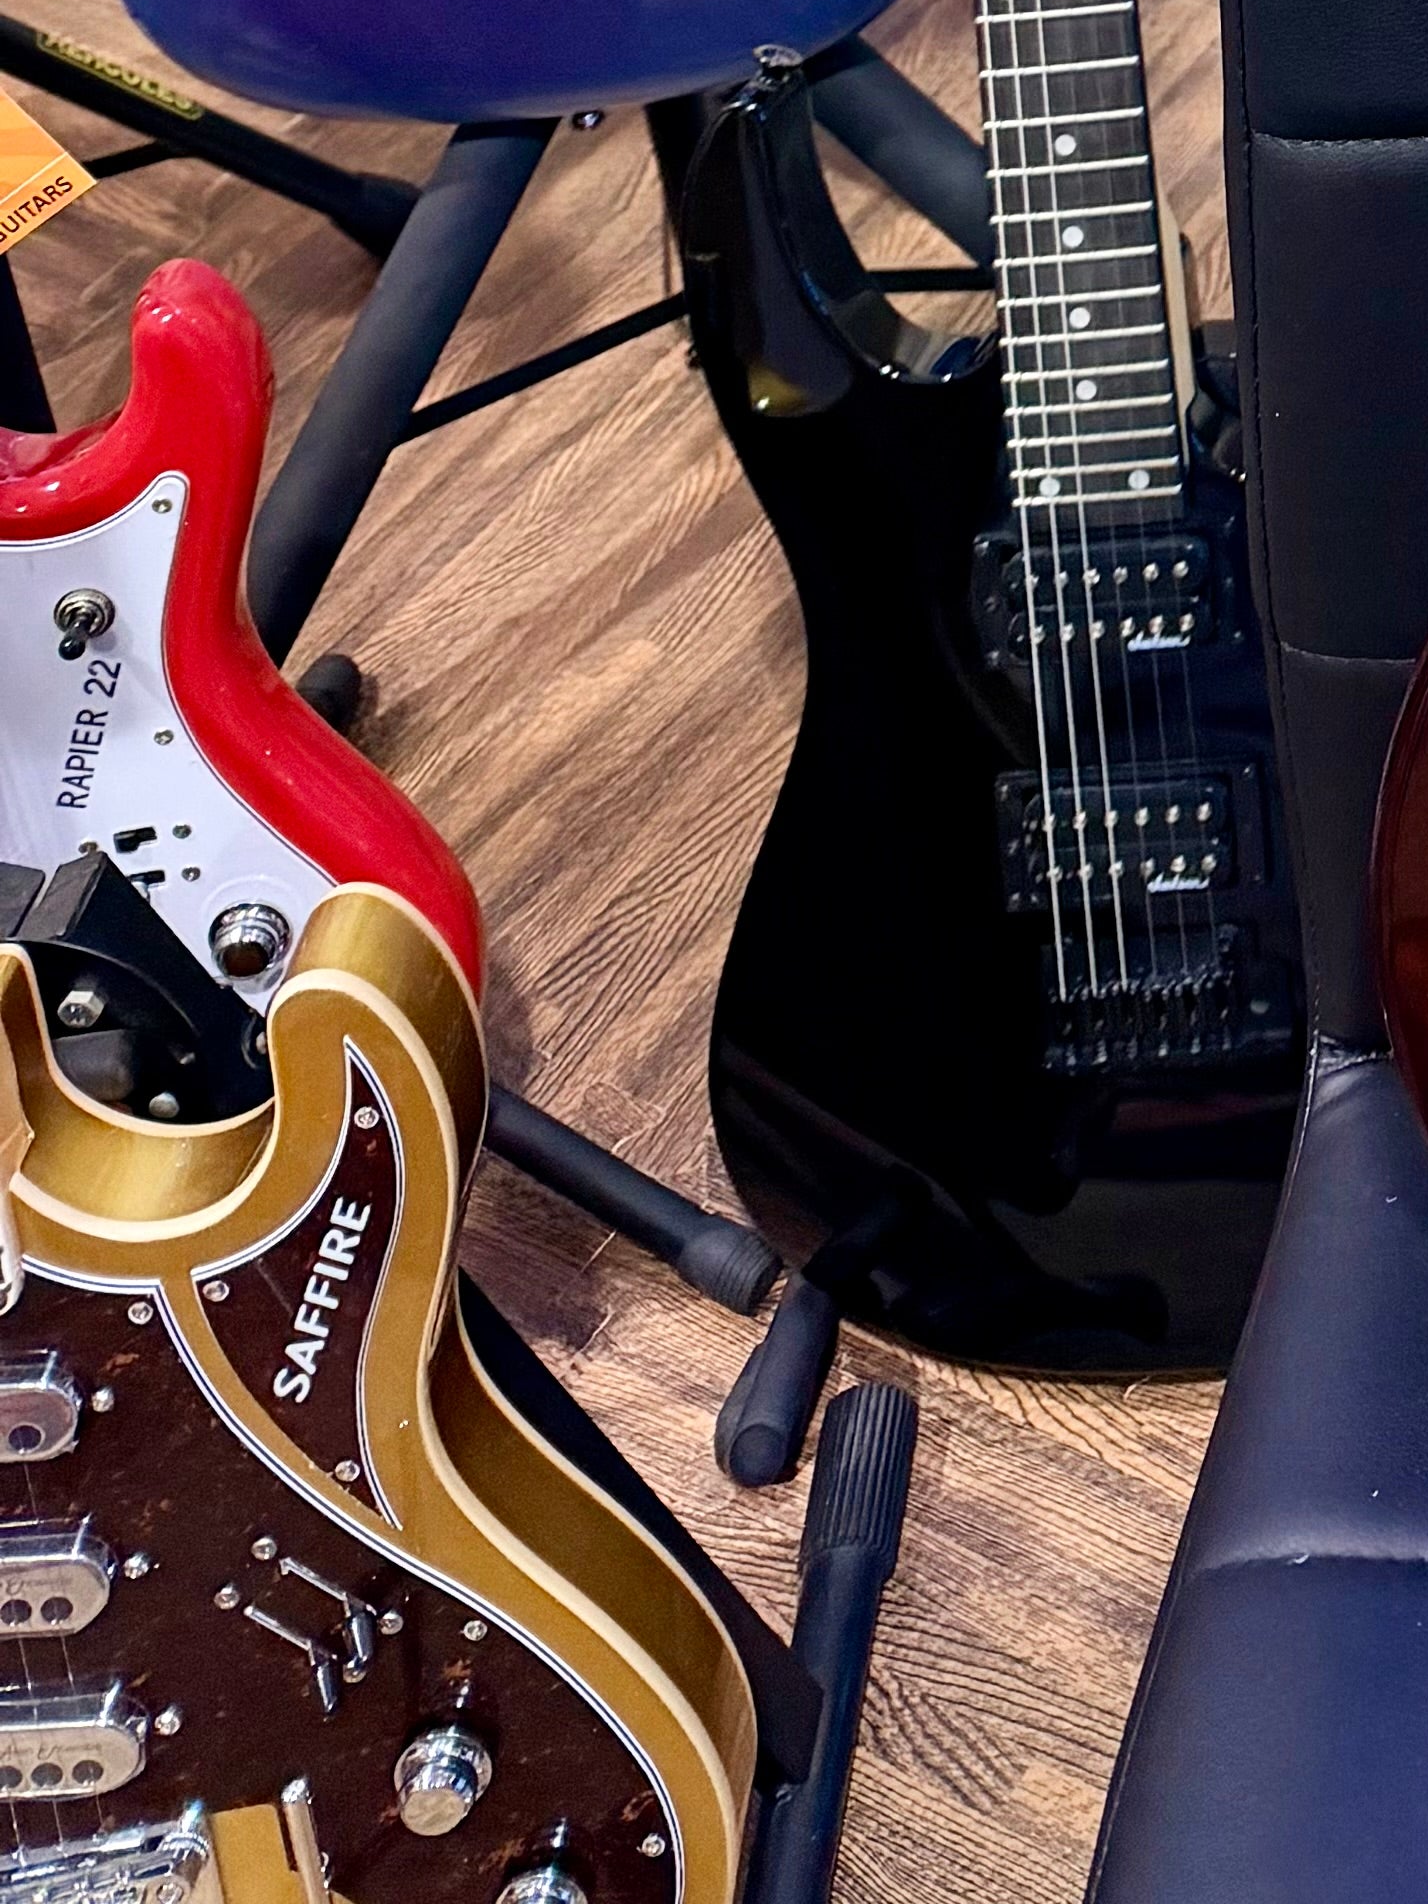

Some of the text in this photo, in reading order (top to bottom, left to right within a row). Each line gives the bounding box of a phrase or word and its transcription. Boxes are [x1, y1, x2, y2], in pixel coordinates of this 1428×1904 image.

[55, 659, 122, 809] RAPIER 22
[272, 1195, 373, 1404] SAFFIRE
